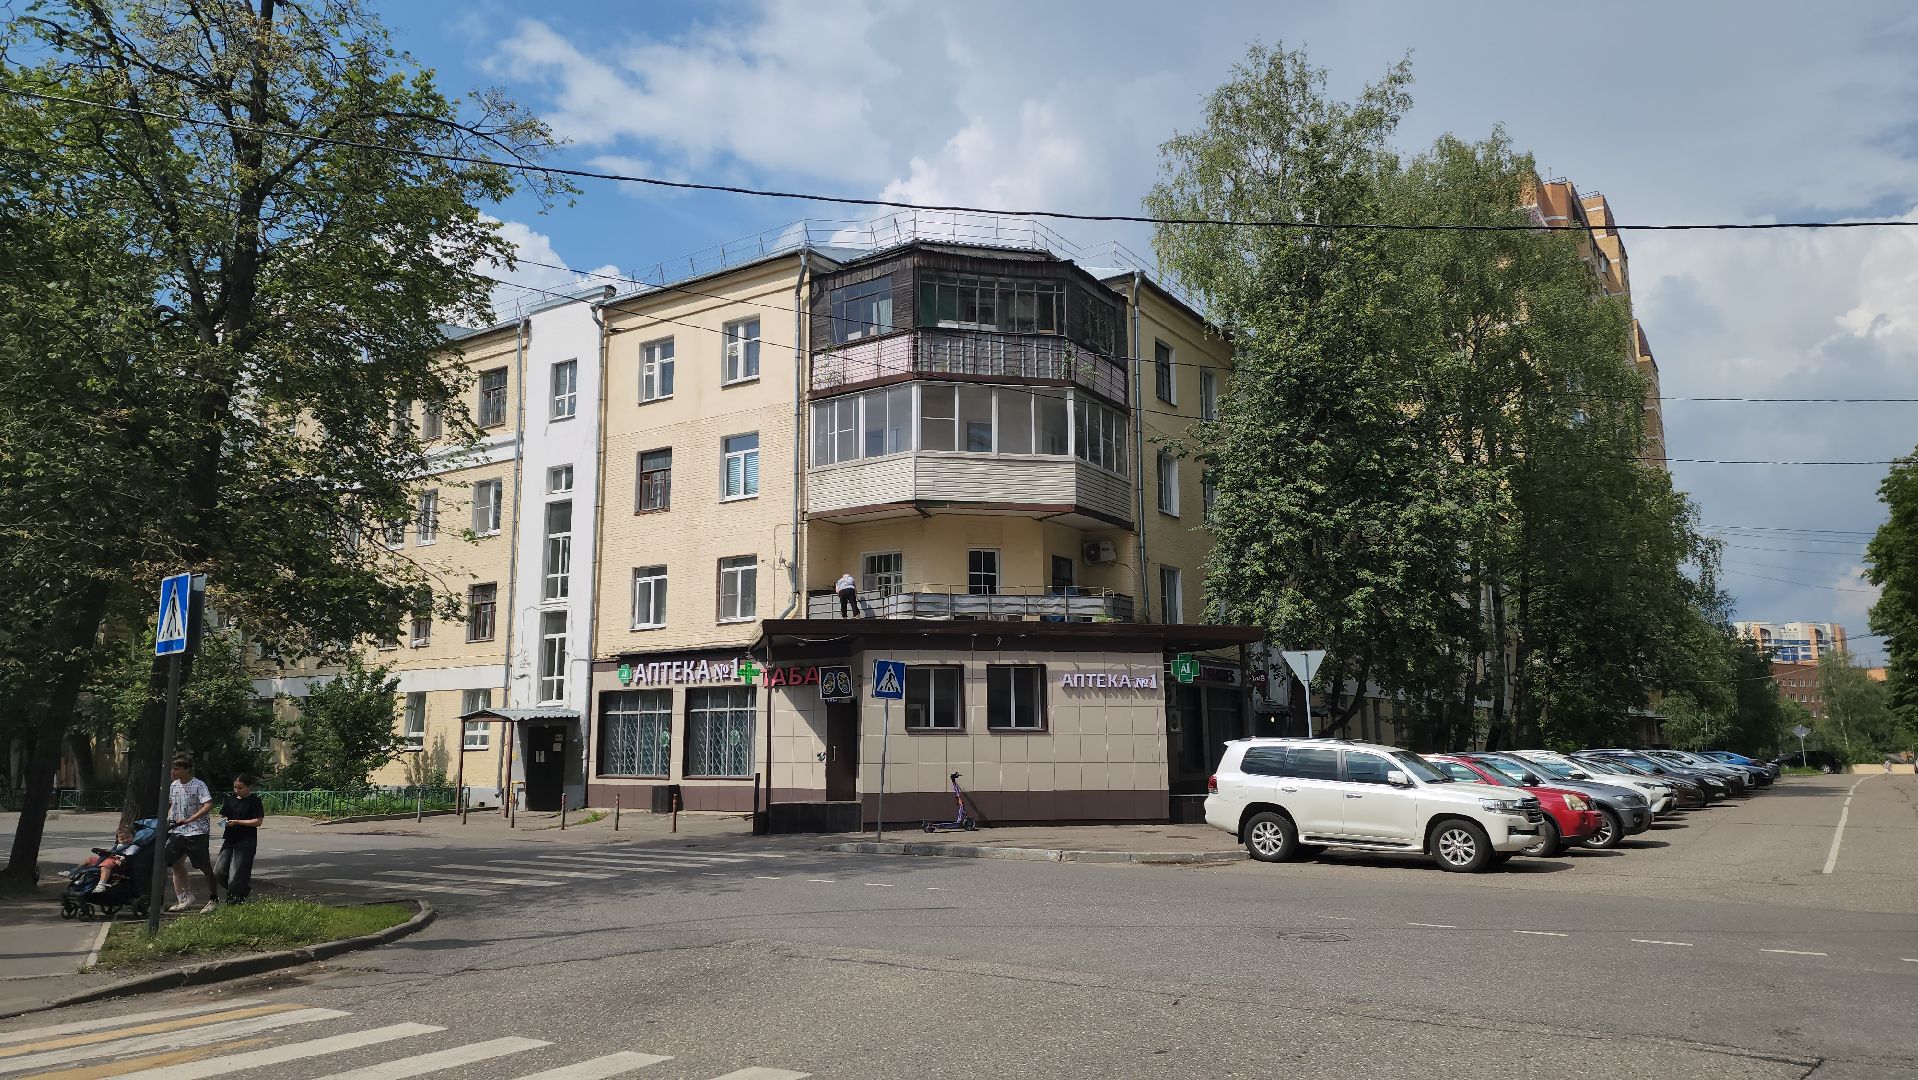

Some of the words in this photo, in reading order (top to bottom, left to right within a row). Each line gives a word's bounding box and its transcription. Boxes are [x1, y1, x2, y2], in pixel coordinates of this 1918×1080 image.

[633, 659, 711, 684] АПТЕКА
[714, 657, 740, 680] №1
[760, 665, 820, 688] ТАБА
[1061, 673, 1132, 689] АПТЕКА
[1134, 673, 1158, 689] №1
